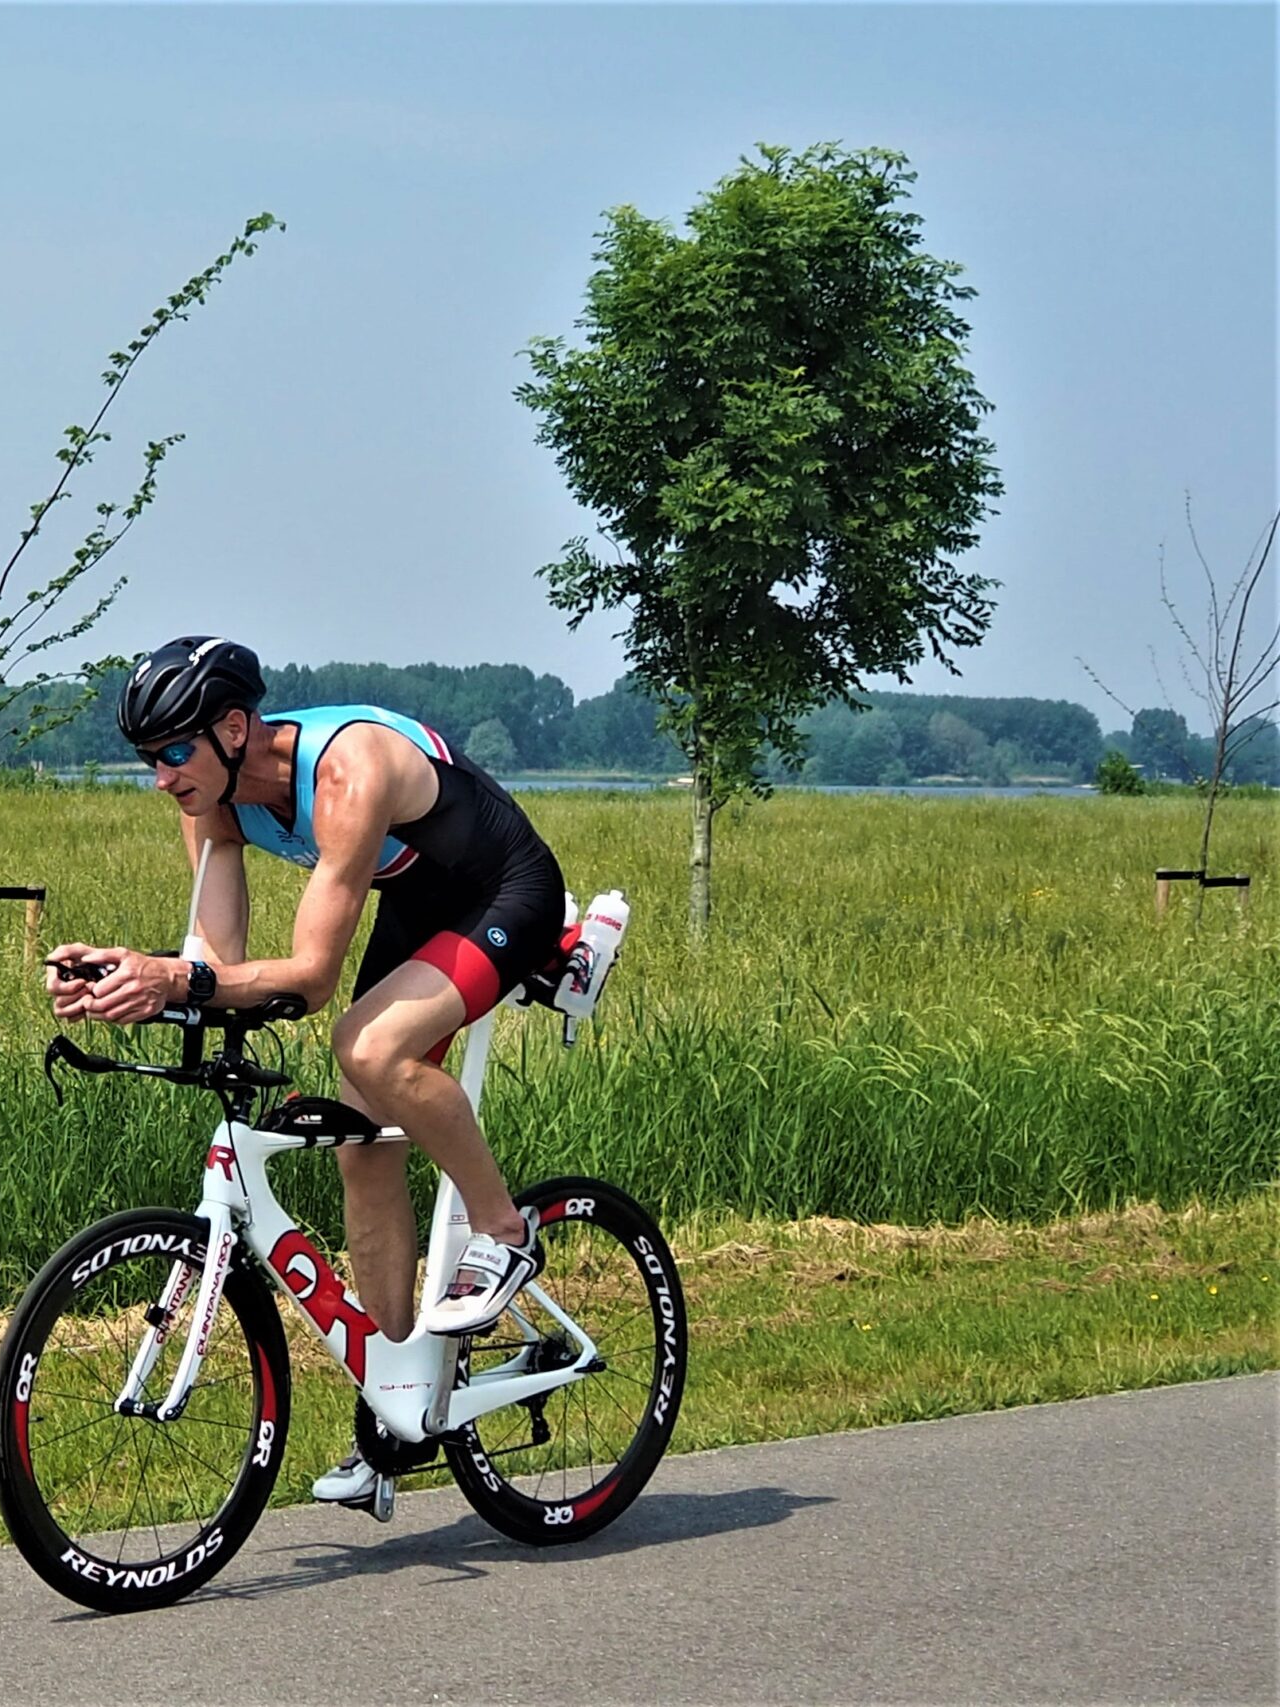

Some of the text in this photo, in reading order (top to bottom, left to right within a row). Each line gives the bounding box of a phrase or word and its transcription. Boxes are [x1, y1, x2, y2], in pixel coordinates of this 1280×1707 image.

[565, 1198, 595, 1217] QR
[71, 1233, 209, 1290] EYNOLDS
[156, 1263, 192, 1344] QNTANA
[633, 1235, 677, 1426] REYNOLDS
[16, 1352, 37, 1402] QR
[252, 1420, 274, 1468] QR
[543, 1505, 574, 1525] QR
[60, 1527, 224, 1589] REYNOLDS
